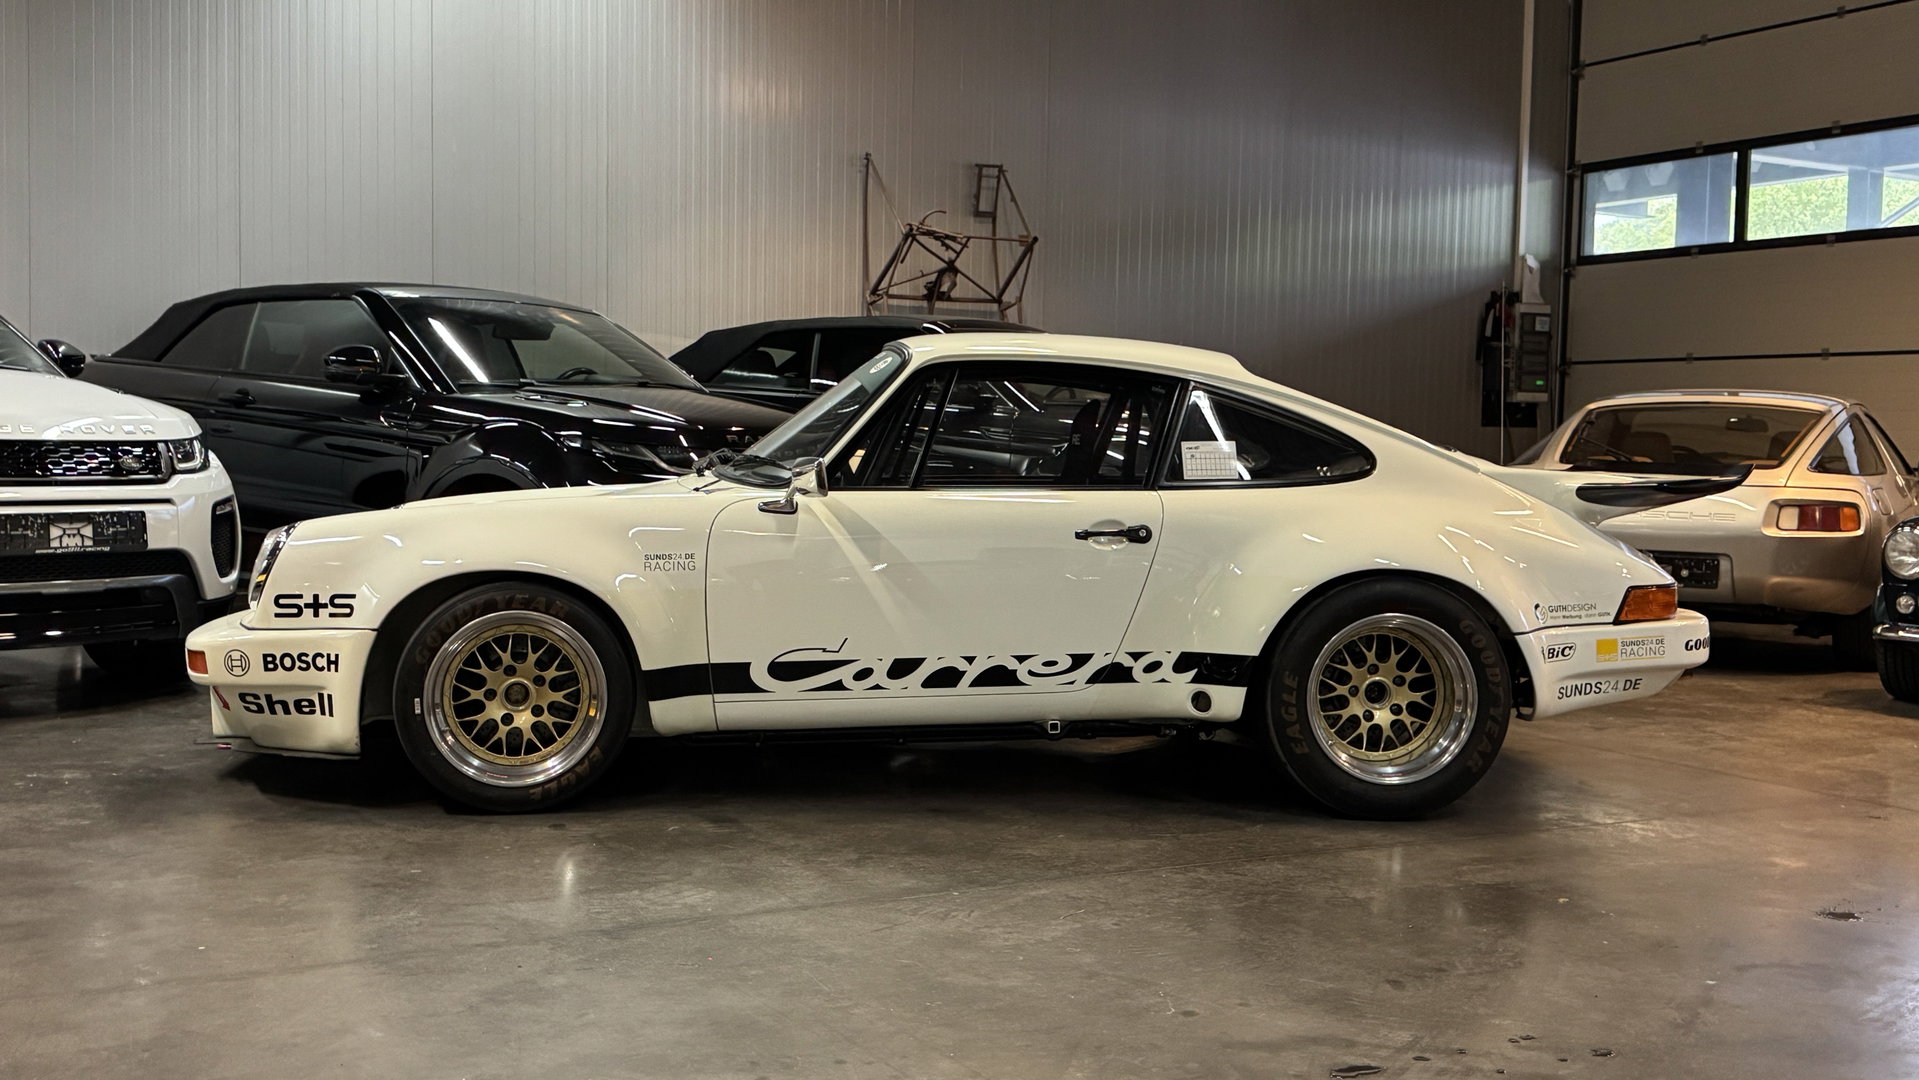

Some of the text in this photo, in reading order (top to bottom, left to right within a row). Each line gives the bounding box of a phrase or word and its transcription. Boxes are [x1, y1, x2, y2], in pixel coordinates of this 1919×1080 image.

[59, 424, 156, 434] ROVER
[1639, 510, 1735, 522] SCHE
[643, 560, 697, 572] RACING
[273, 593, 357, 618] S+S
[262, 652, 339, 673] BOSCH
[1620, 646, 1665, 658] RACING
[750, 638, 1199, 693] Carrera
[1557, 678, 1644, 700] SUNDS24.DE
[238, 692, 334, 718] Shell
[1280, 671, 1311, 755] EAGLE
[529, 746, 604, 801] EAGLE
